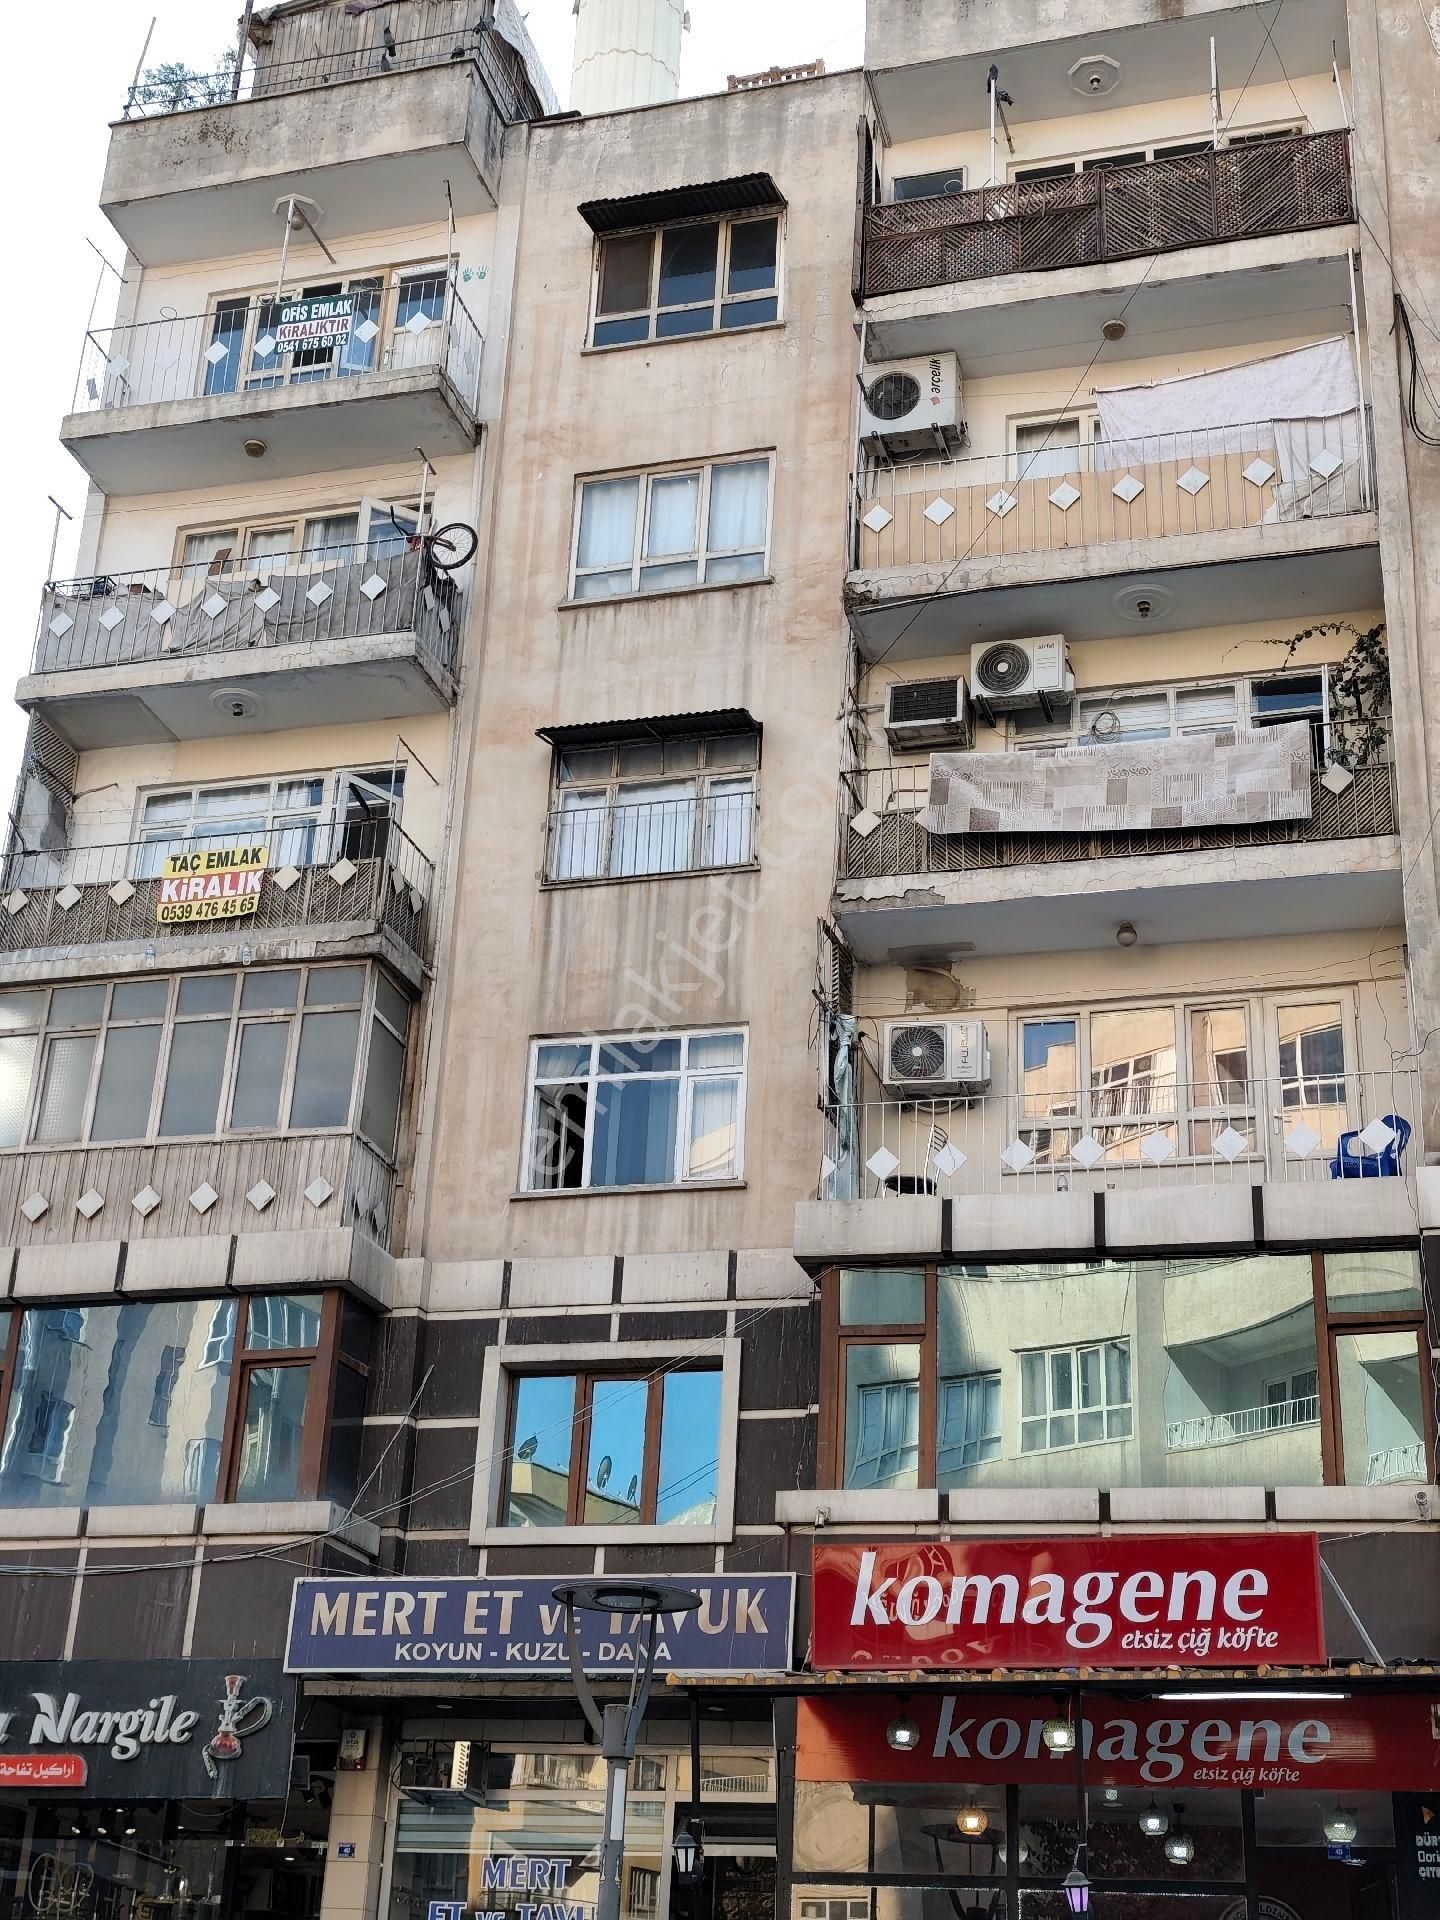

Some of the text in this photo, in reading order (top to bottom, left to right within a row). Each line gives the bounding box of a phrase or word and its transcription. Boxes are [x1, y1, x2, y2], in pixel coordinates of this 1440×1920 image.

[281, 300, 352, 322] OFİS EMLAK
[277, 333, 347, 353] 0541 675 60 02
[170, 847, 262, 875] TAÇ EMLAK
[161, 896, 255, 921] 0539 476 45 65
[310, 1591, 448, 1636] MERT
[463, 1590, 524, 1635] ET
[850, 1551, 1269, 1650] komagene
[394, 1642, 482, 1661] KOYUN
[1121, 1625, 1279, 1657] etsiz çiğ köfte
[29, 1692, 200, 1760] Nargile
[0, 1760, 75, 1779] أراكيل تفاحة
[1193, 1767, 1300, 1785] etsiz çiğ köfte
[480, 1857, 572, 1890] MERT
